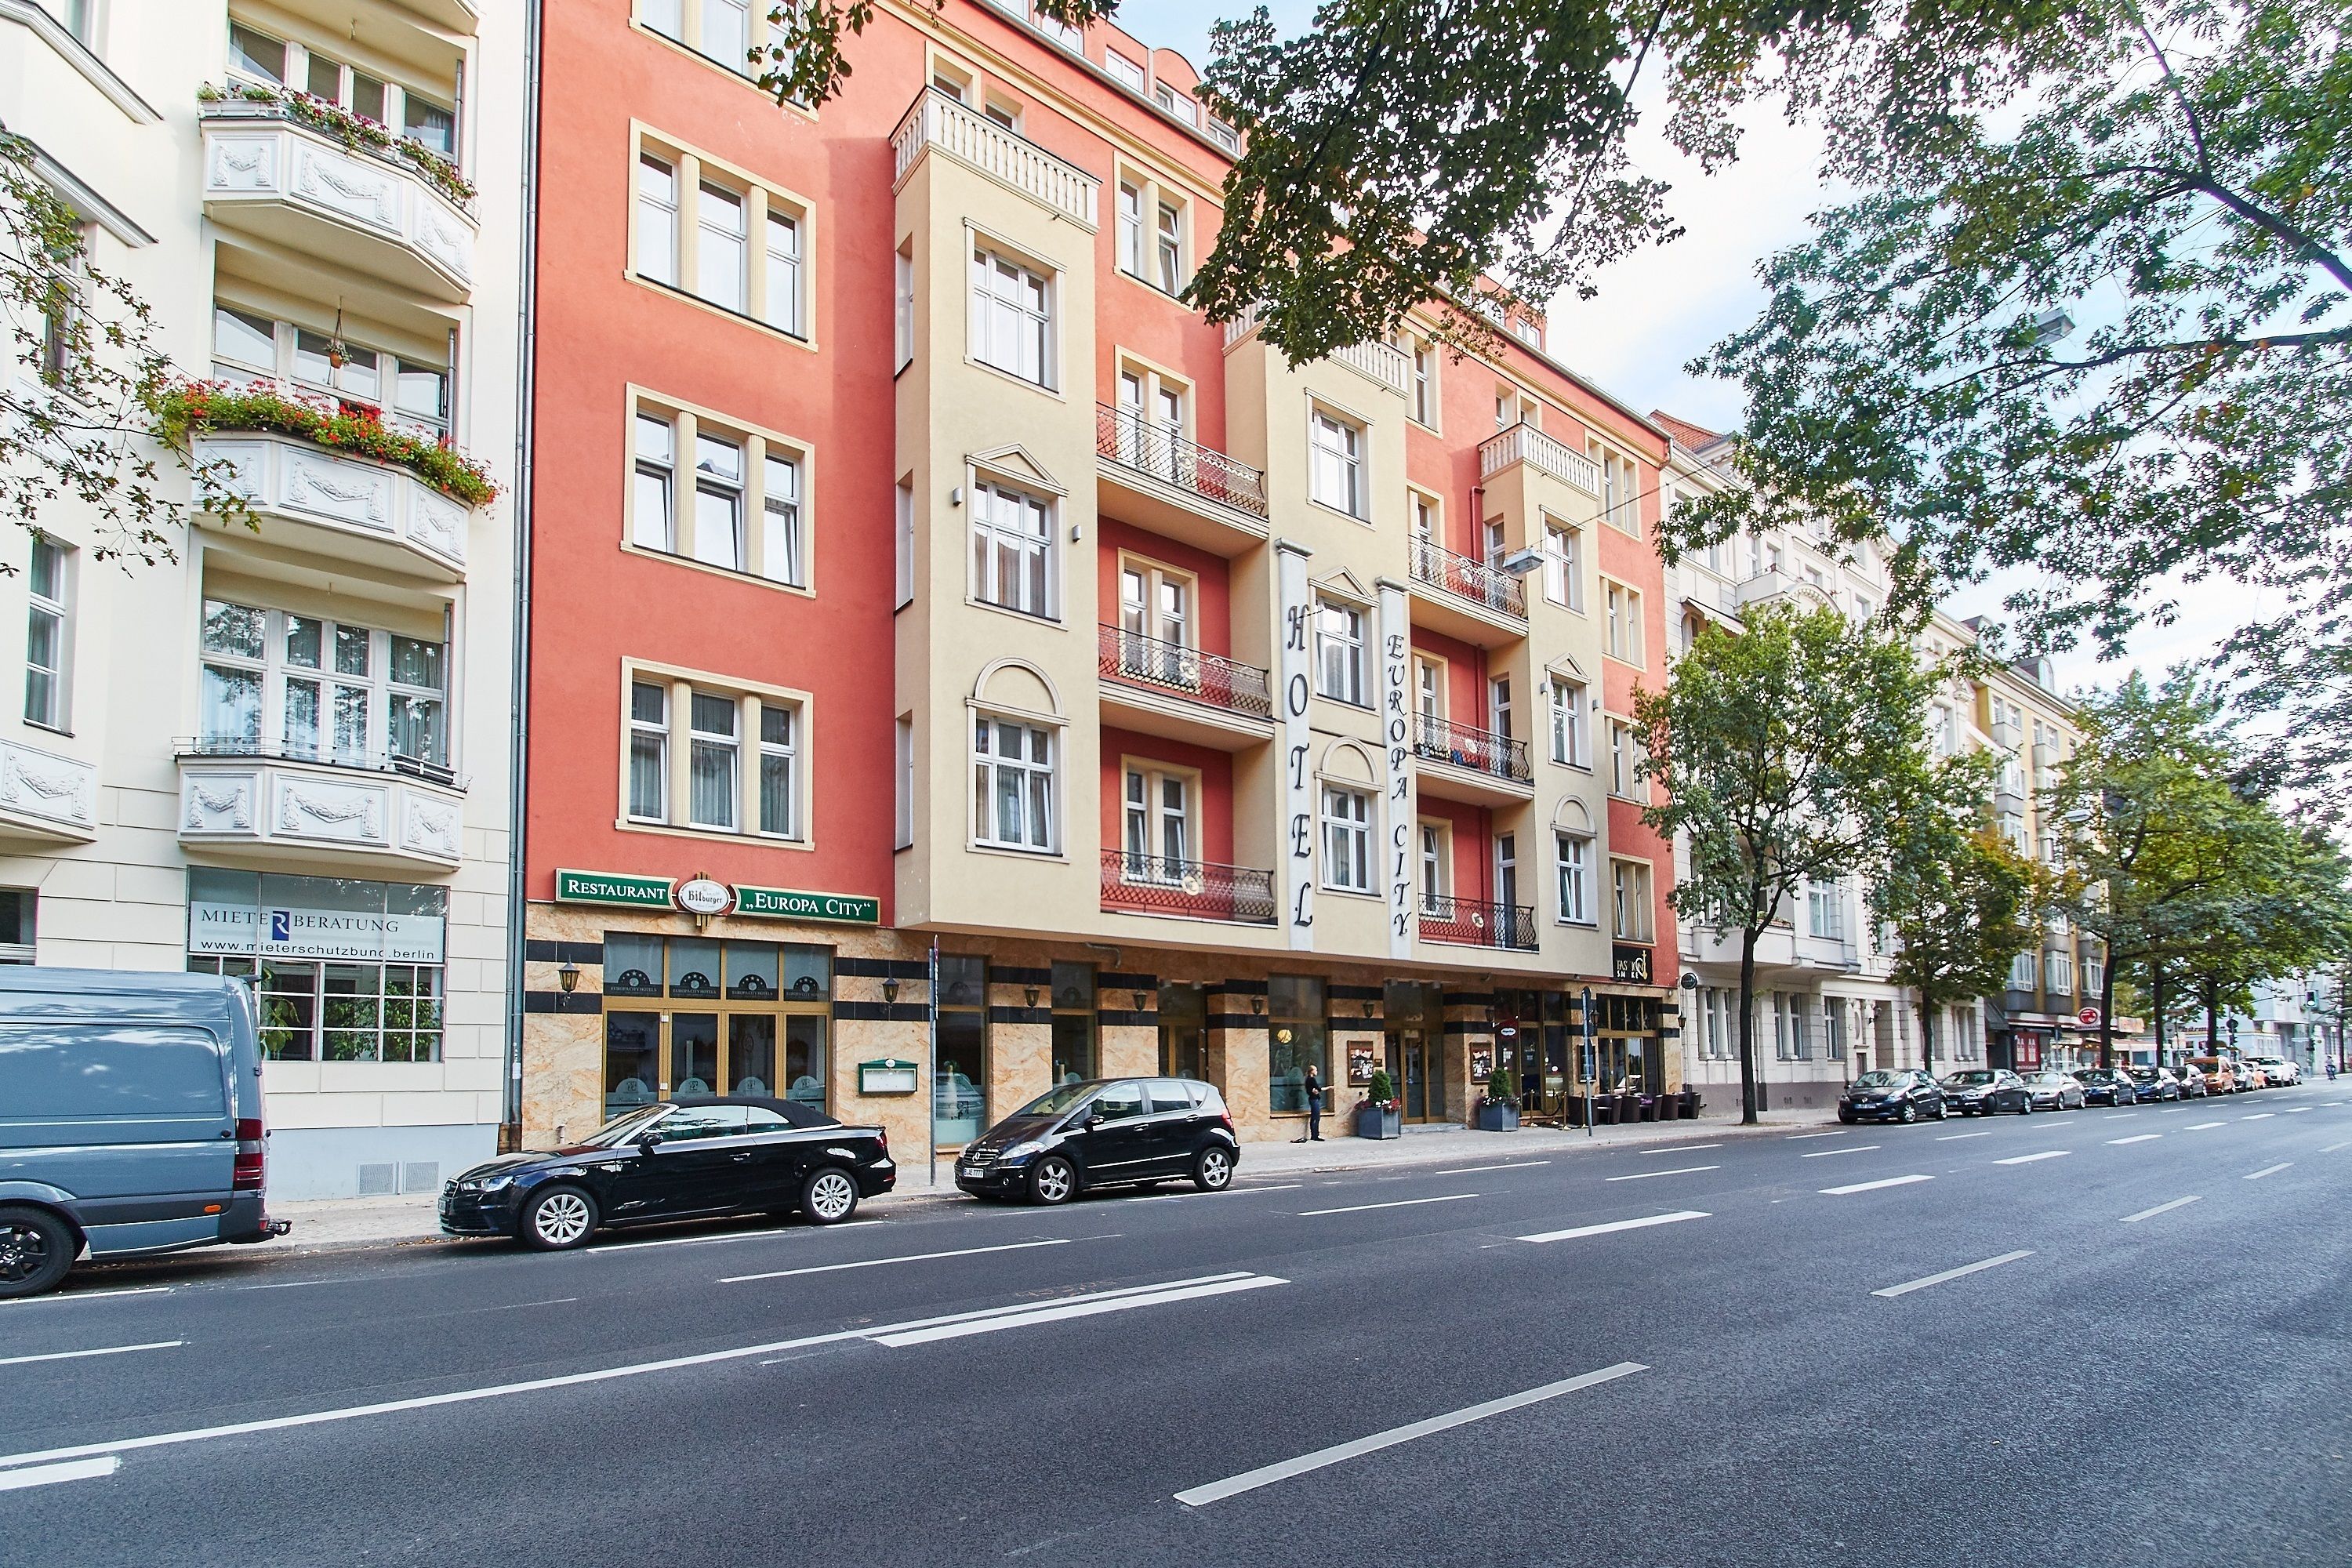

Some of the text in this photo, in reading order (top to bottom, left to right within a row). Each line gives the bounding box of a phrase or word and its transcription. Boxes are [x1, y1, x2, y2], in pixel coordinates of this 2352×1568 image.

[1287, 603, 1312, 927] HOTEL
[1388, 634, 1412, 937] EUROPA CITY
[567, 879, 666, 900] RESTAURANT
[688, 890, 723, 905] Bitburger
